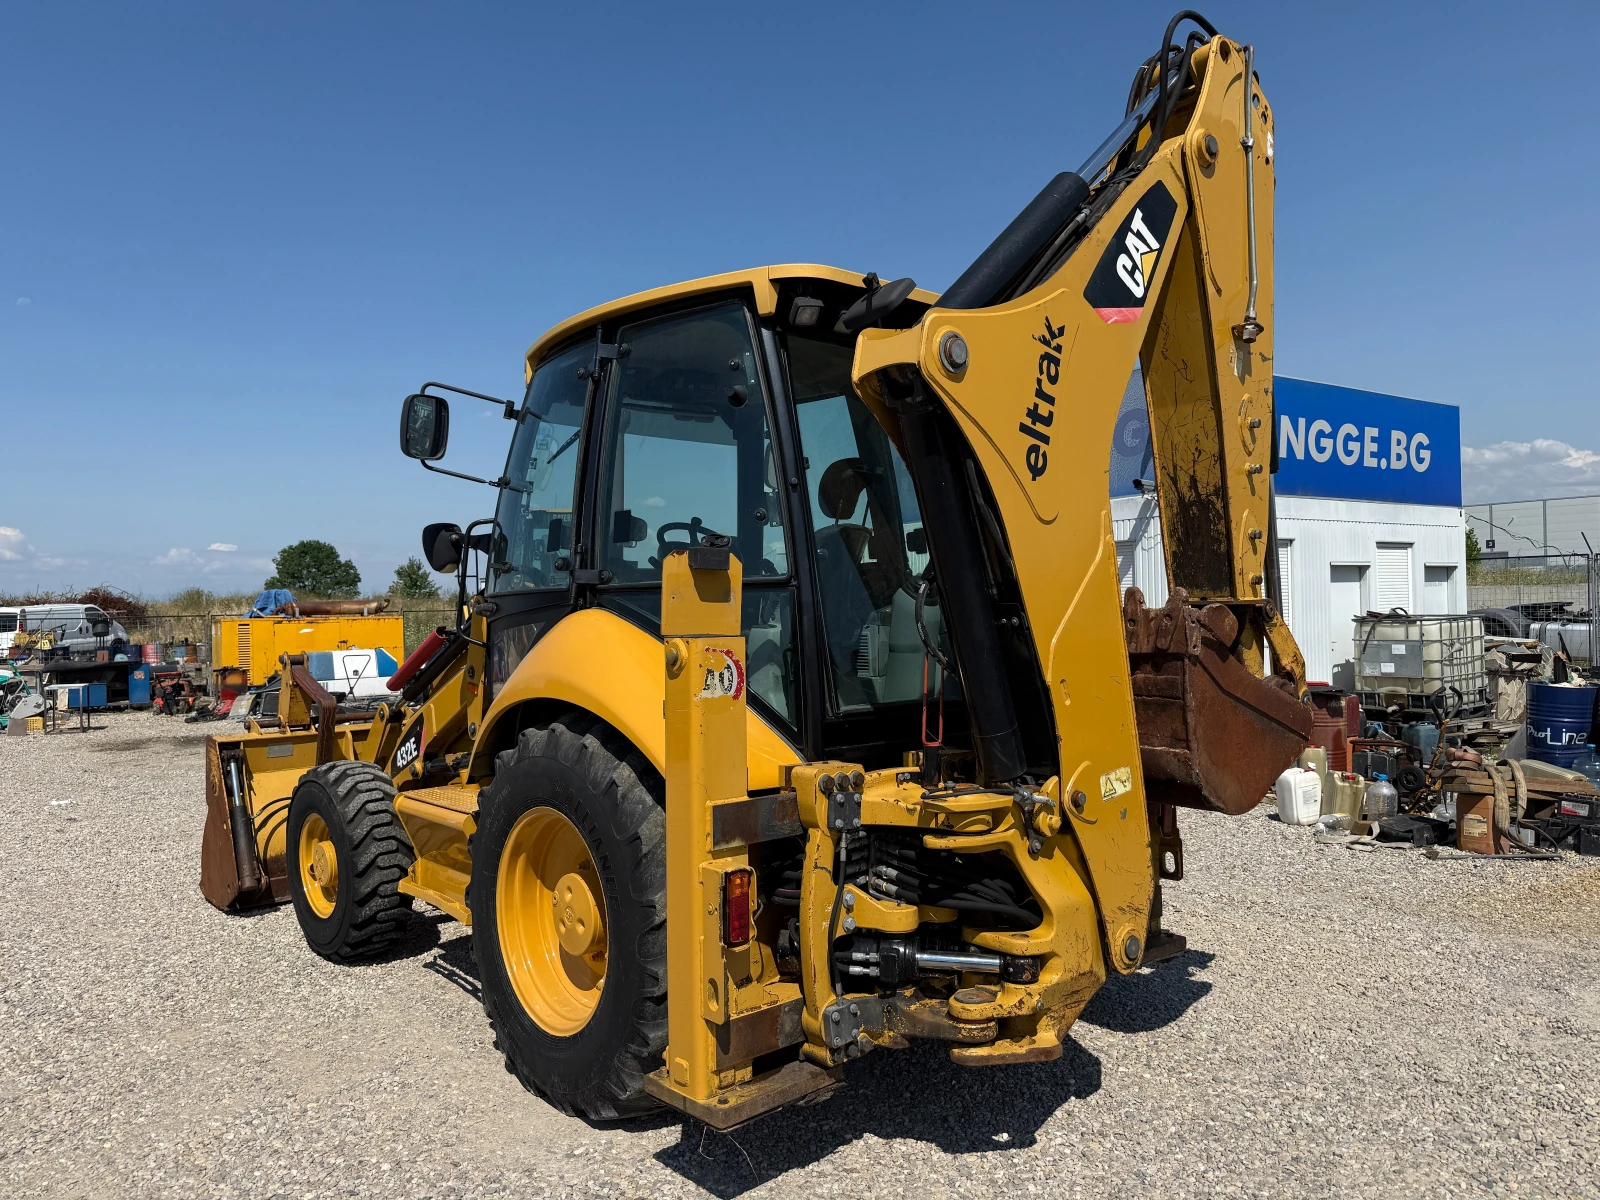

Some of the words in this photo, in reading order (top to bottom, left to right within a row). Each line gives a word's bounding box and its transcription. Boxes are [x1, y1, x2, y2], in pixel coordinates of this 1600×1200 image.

[1116, 207, 1160, 299] CAT
[1019, 315, 1066, 482] eltrak
[1279, 414, 1431, 473] NGGE.BG
[396, 736, 418, 768] 432E
[564, 789, 622, 911] ALLIANCE
